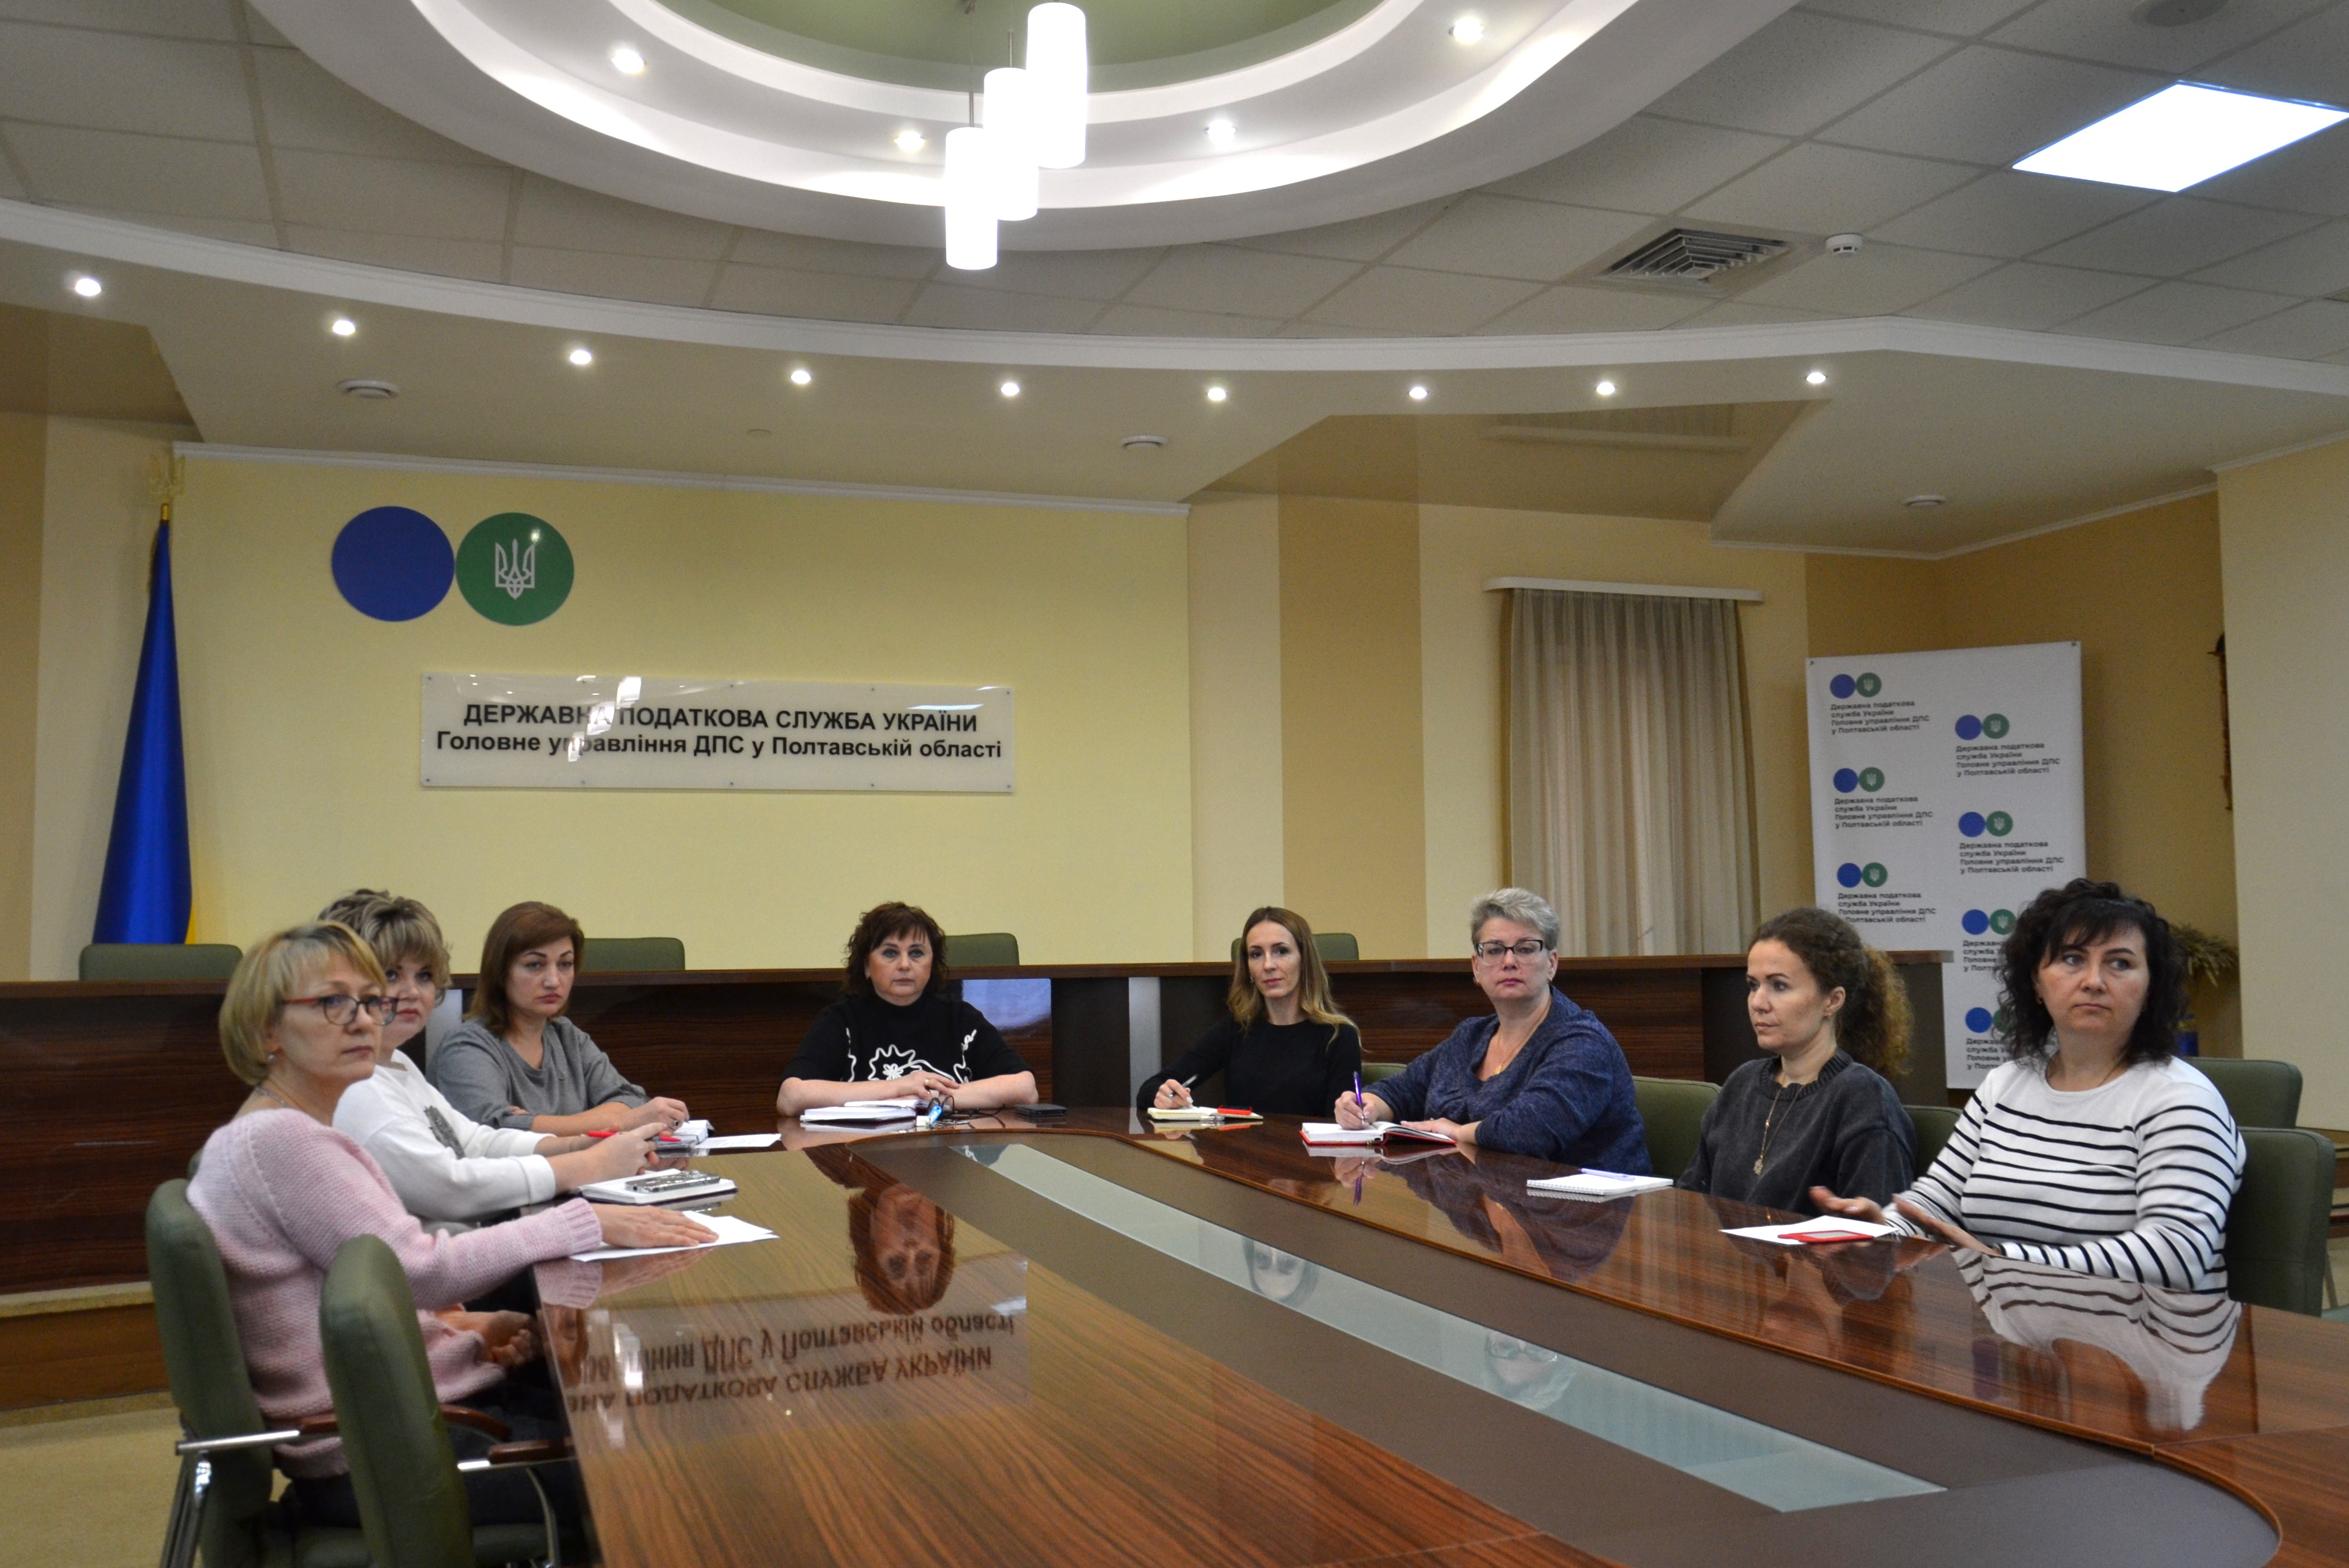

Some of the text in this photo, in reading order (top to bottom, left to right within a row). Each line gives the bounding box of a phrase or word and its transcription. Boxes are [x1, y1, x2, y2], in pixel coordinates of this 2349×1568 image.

[464, 704, 976, 732] ДЕРЖАВНА ПОДАТКОВА СЛУЖБА УКРАЇНИ
[1831, 710, 1861, 719] служба
[1864, 716, 1910, 725] управління
[437, 731, 541, 751] Головне
[694, 736, 743, 757] ДПС
[752, 740, 764, 758] у
[773, 737, 911, 756] Полтавській
[920, 740, 1002, 757] області
